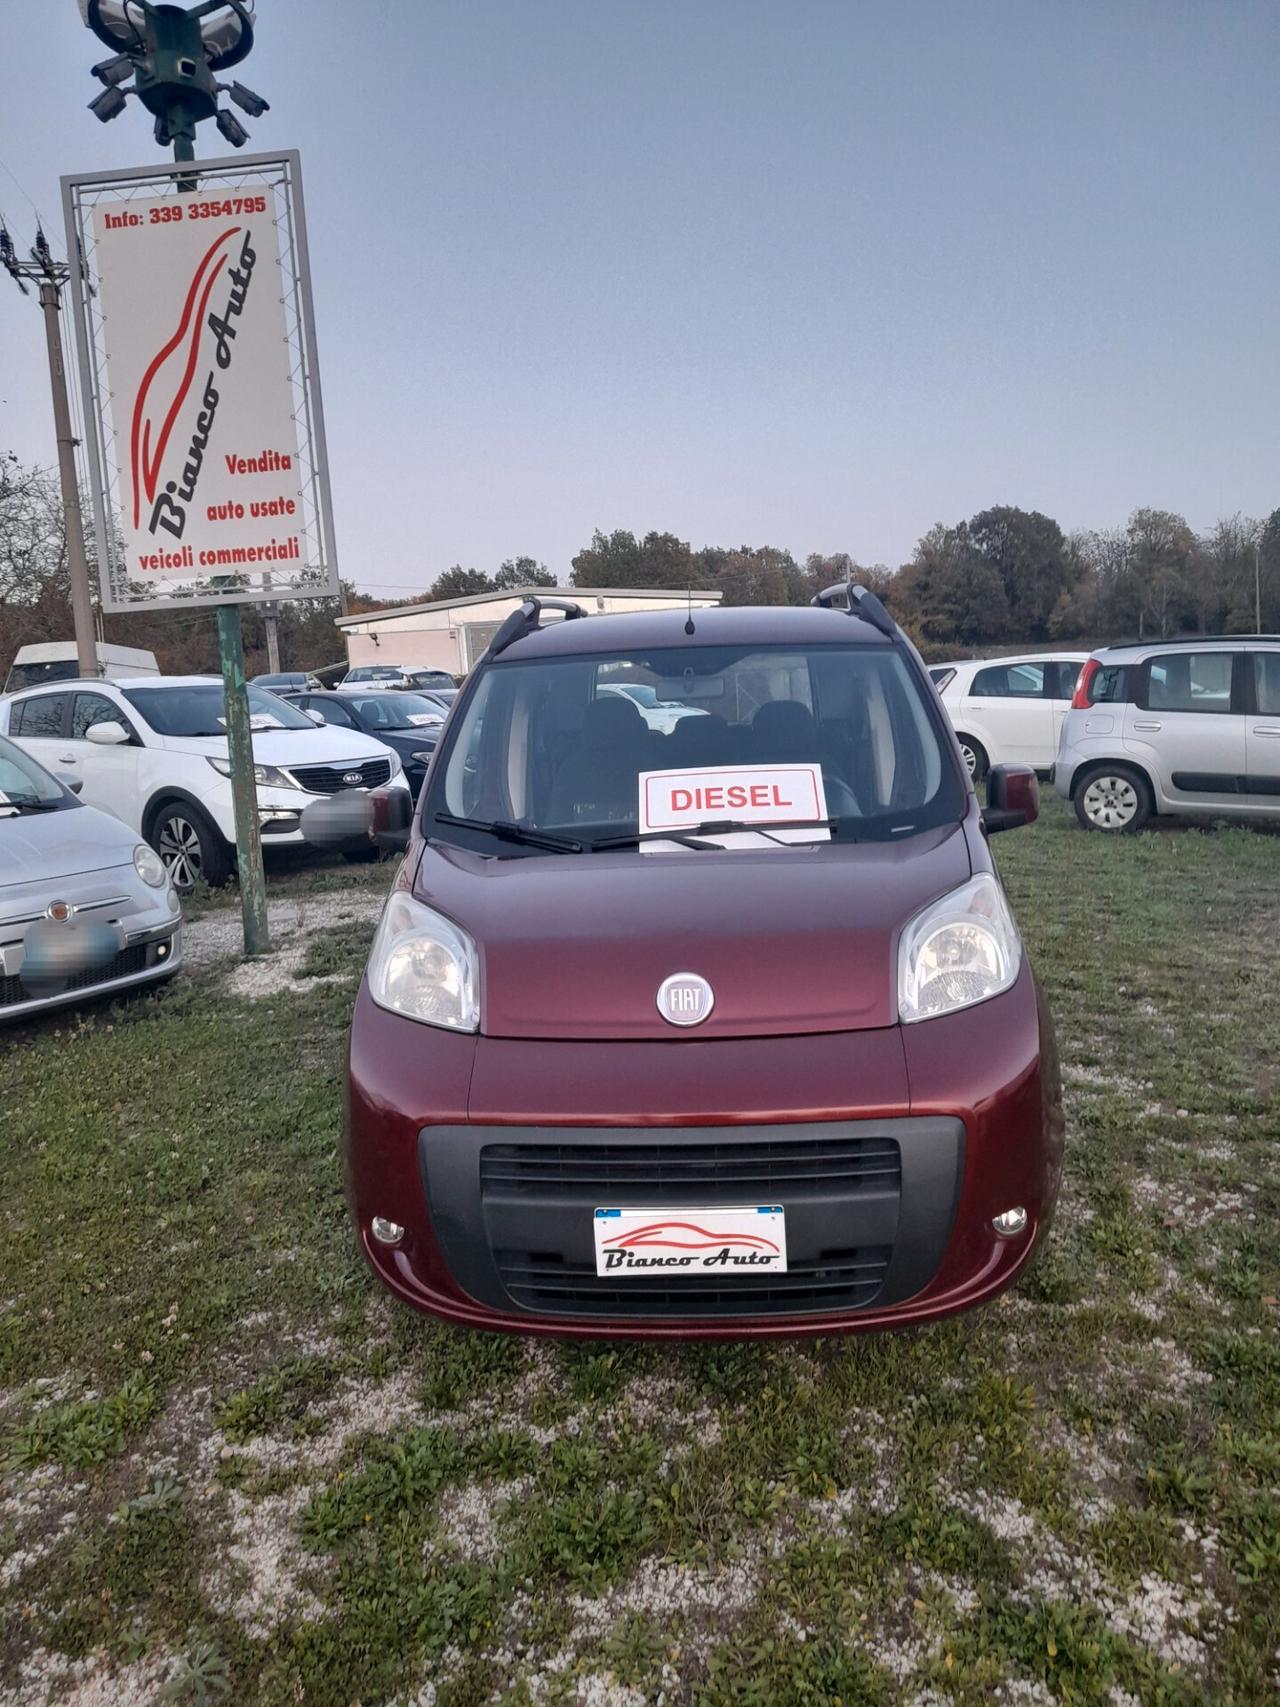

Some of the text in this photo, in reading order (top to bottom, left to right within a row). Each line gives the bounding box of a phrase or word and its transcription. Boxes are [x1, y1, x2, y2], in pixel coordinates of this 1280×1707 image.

[104, 196, 267, 229] Info: 339 3354795
[148, 229, 257, 540] Bianco Auto
[225, 449, 292, 475] Vendita
[207, 496, 296, 521] auto usate
[138, 536, 300, 570] veicoli commerciali
[671, 784, 793, 812] DIESEL
[670, 988, 702, 1011] FIAT
[602, 1248, 780, 1269] Bianco Auto
